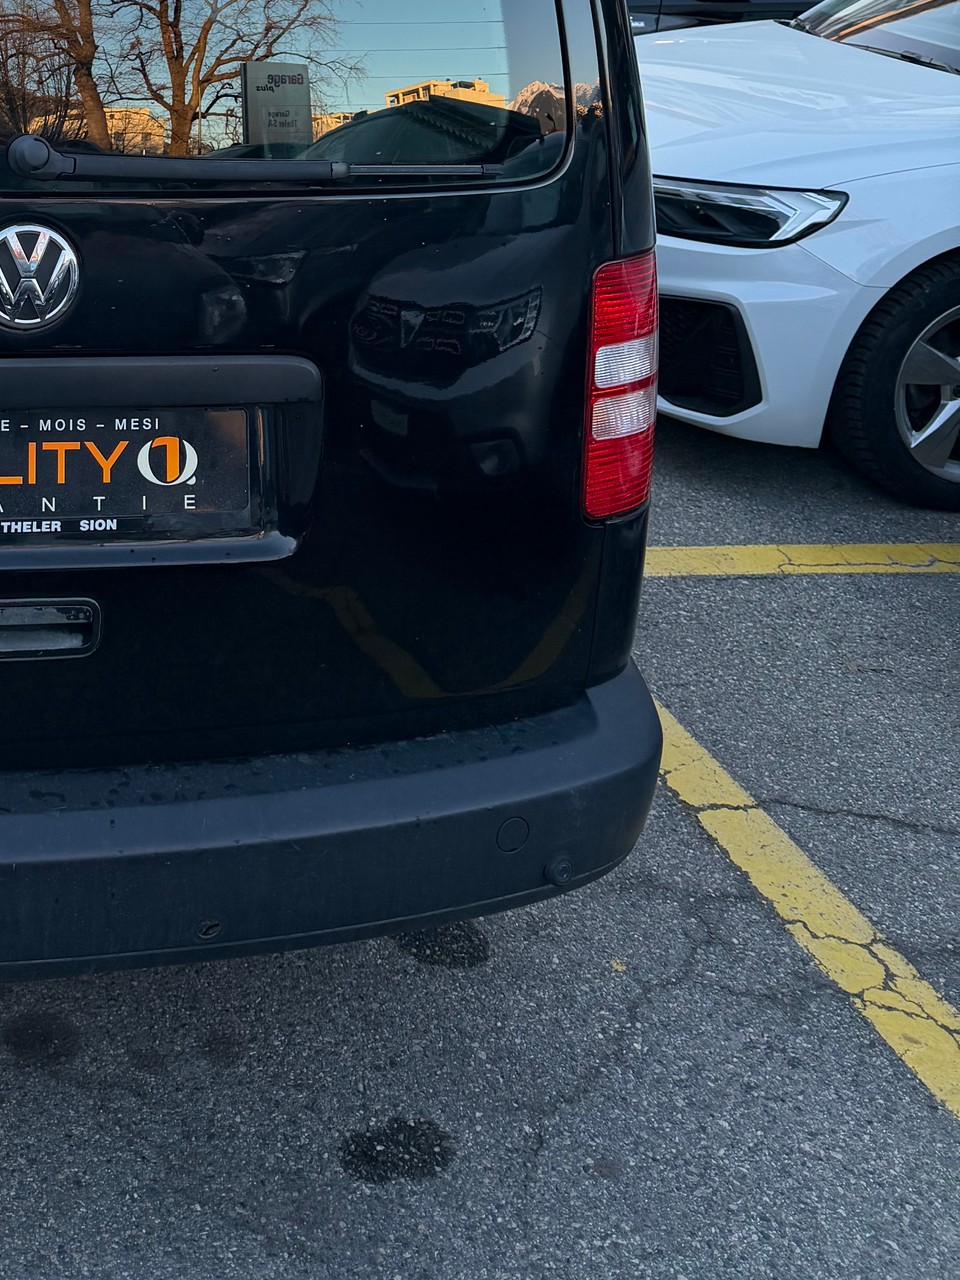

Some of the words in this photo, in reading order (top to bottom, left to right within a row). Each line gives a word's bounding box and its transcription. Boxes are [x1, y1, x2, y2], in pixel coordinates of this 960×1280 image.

[39, 418, 87, 432] MOIS
[114, 417, 160, 431] MESI
[1, 520, 62, 533] THELER
[79, 519, 118, 532] SION
